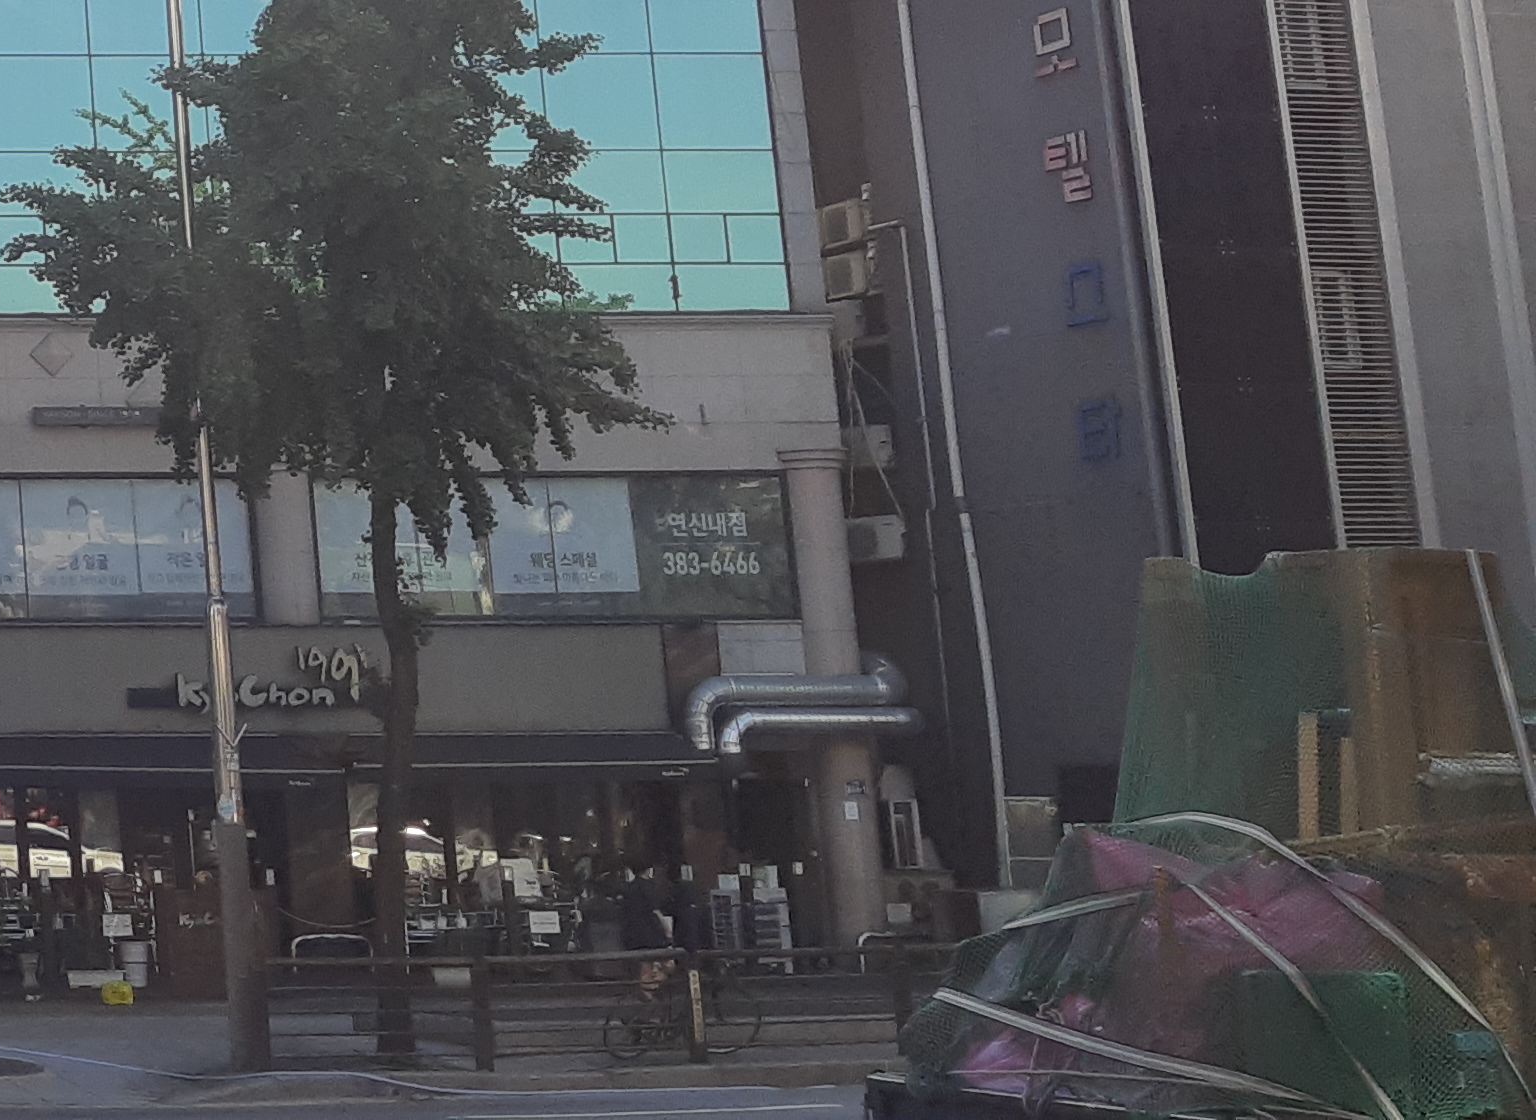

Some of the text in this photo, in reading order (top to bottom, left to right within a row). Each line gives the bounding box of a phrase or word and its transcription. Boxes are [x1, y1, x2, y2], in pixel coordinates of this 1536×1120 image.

[667, 512, 748, 537] 연신내점
[662, 551, 761, 575] 383-6466
[176, 673, 336, 715] KyChon
